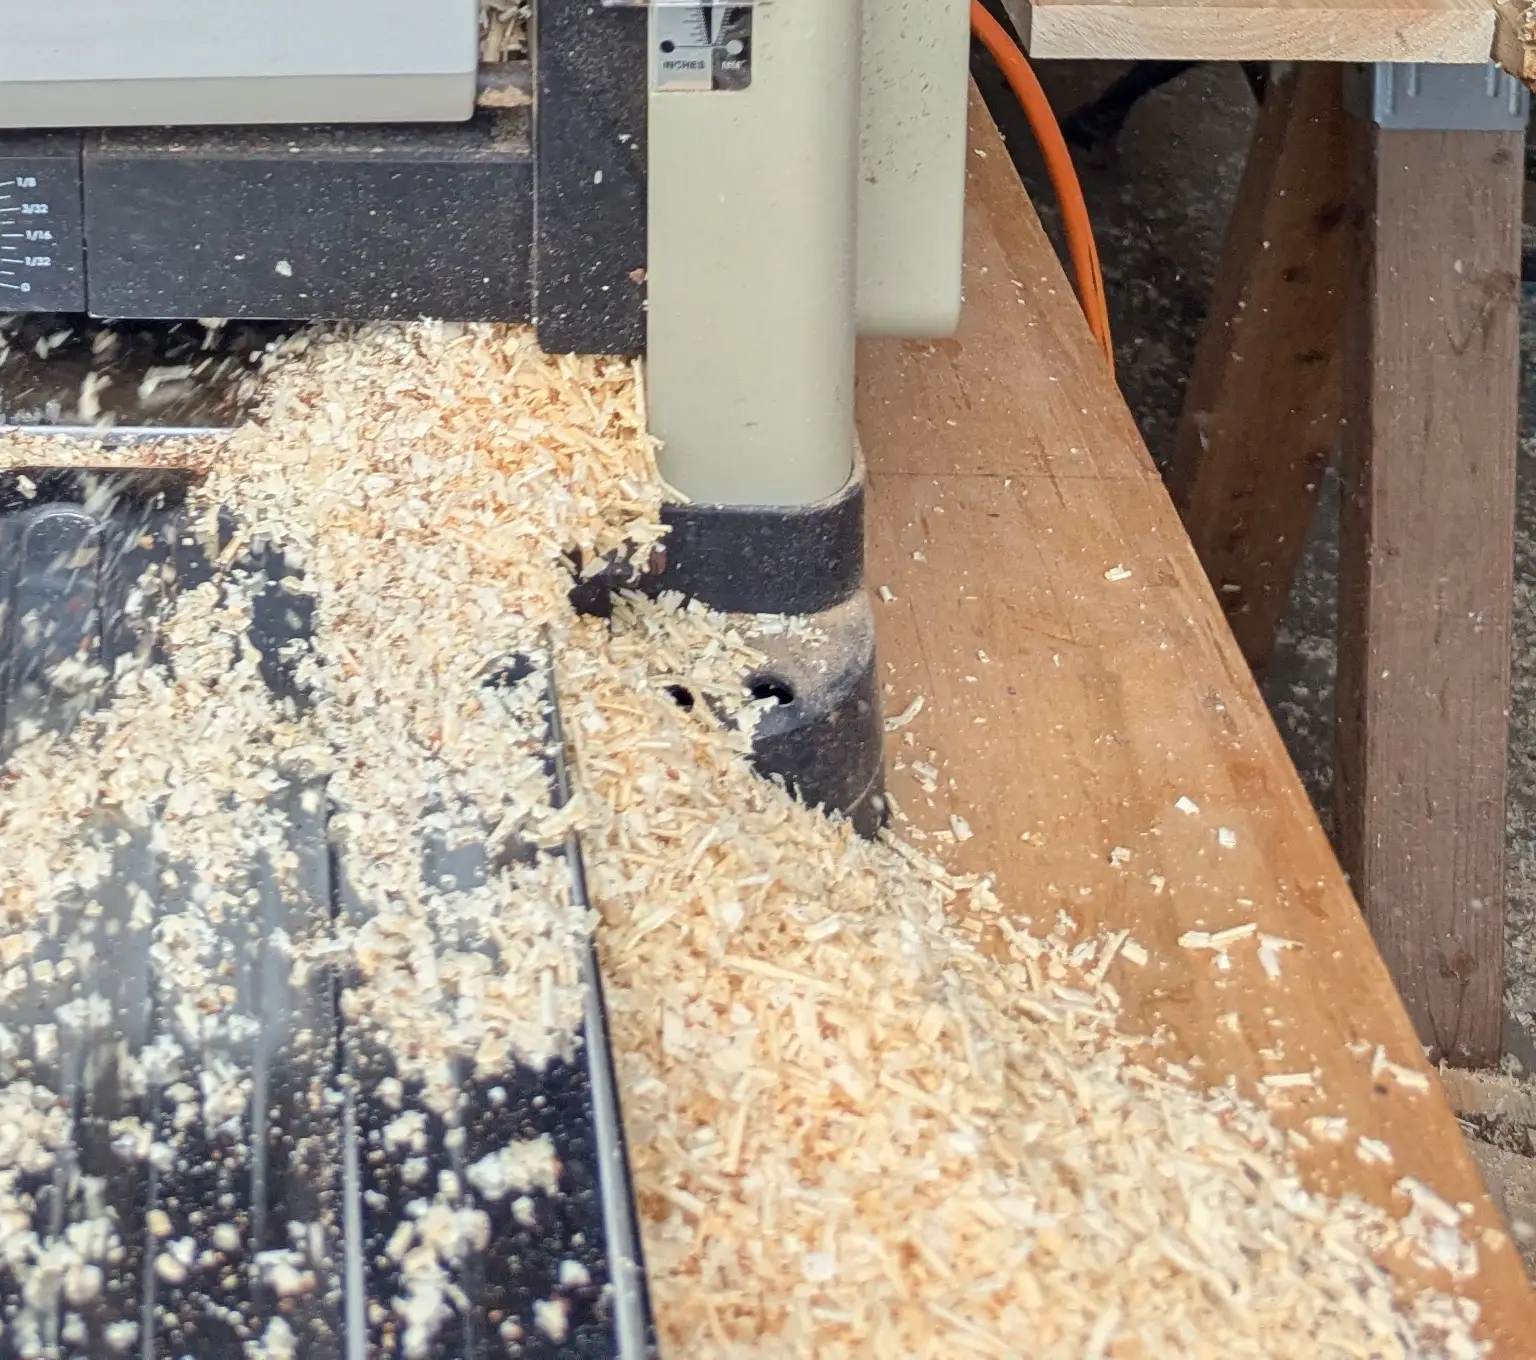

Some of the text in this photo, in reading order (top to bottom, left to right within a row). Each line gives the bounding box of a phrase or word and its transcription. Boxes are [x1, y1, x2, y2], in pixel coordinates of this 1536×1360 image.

[16, 177, 37, 187] 1/8
[25, 230, 53, 240] 1/16
[24, 256, 51, 266] 1/32
[20, 282, 31, 292] 0
